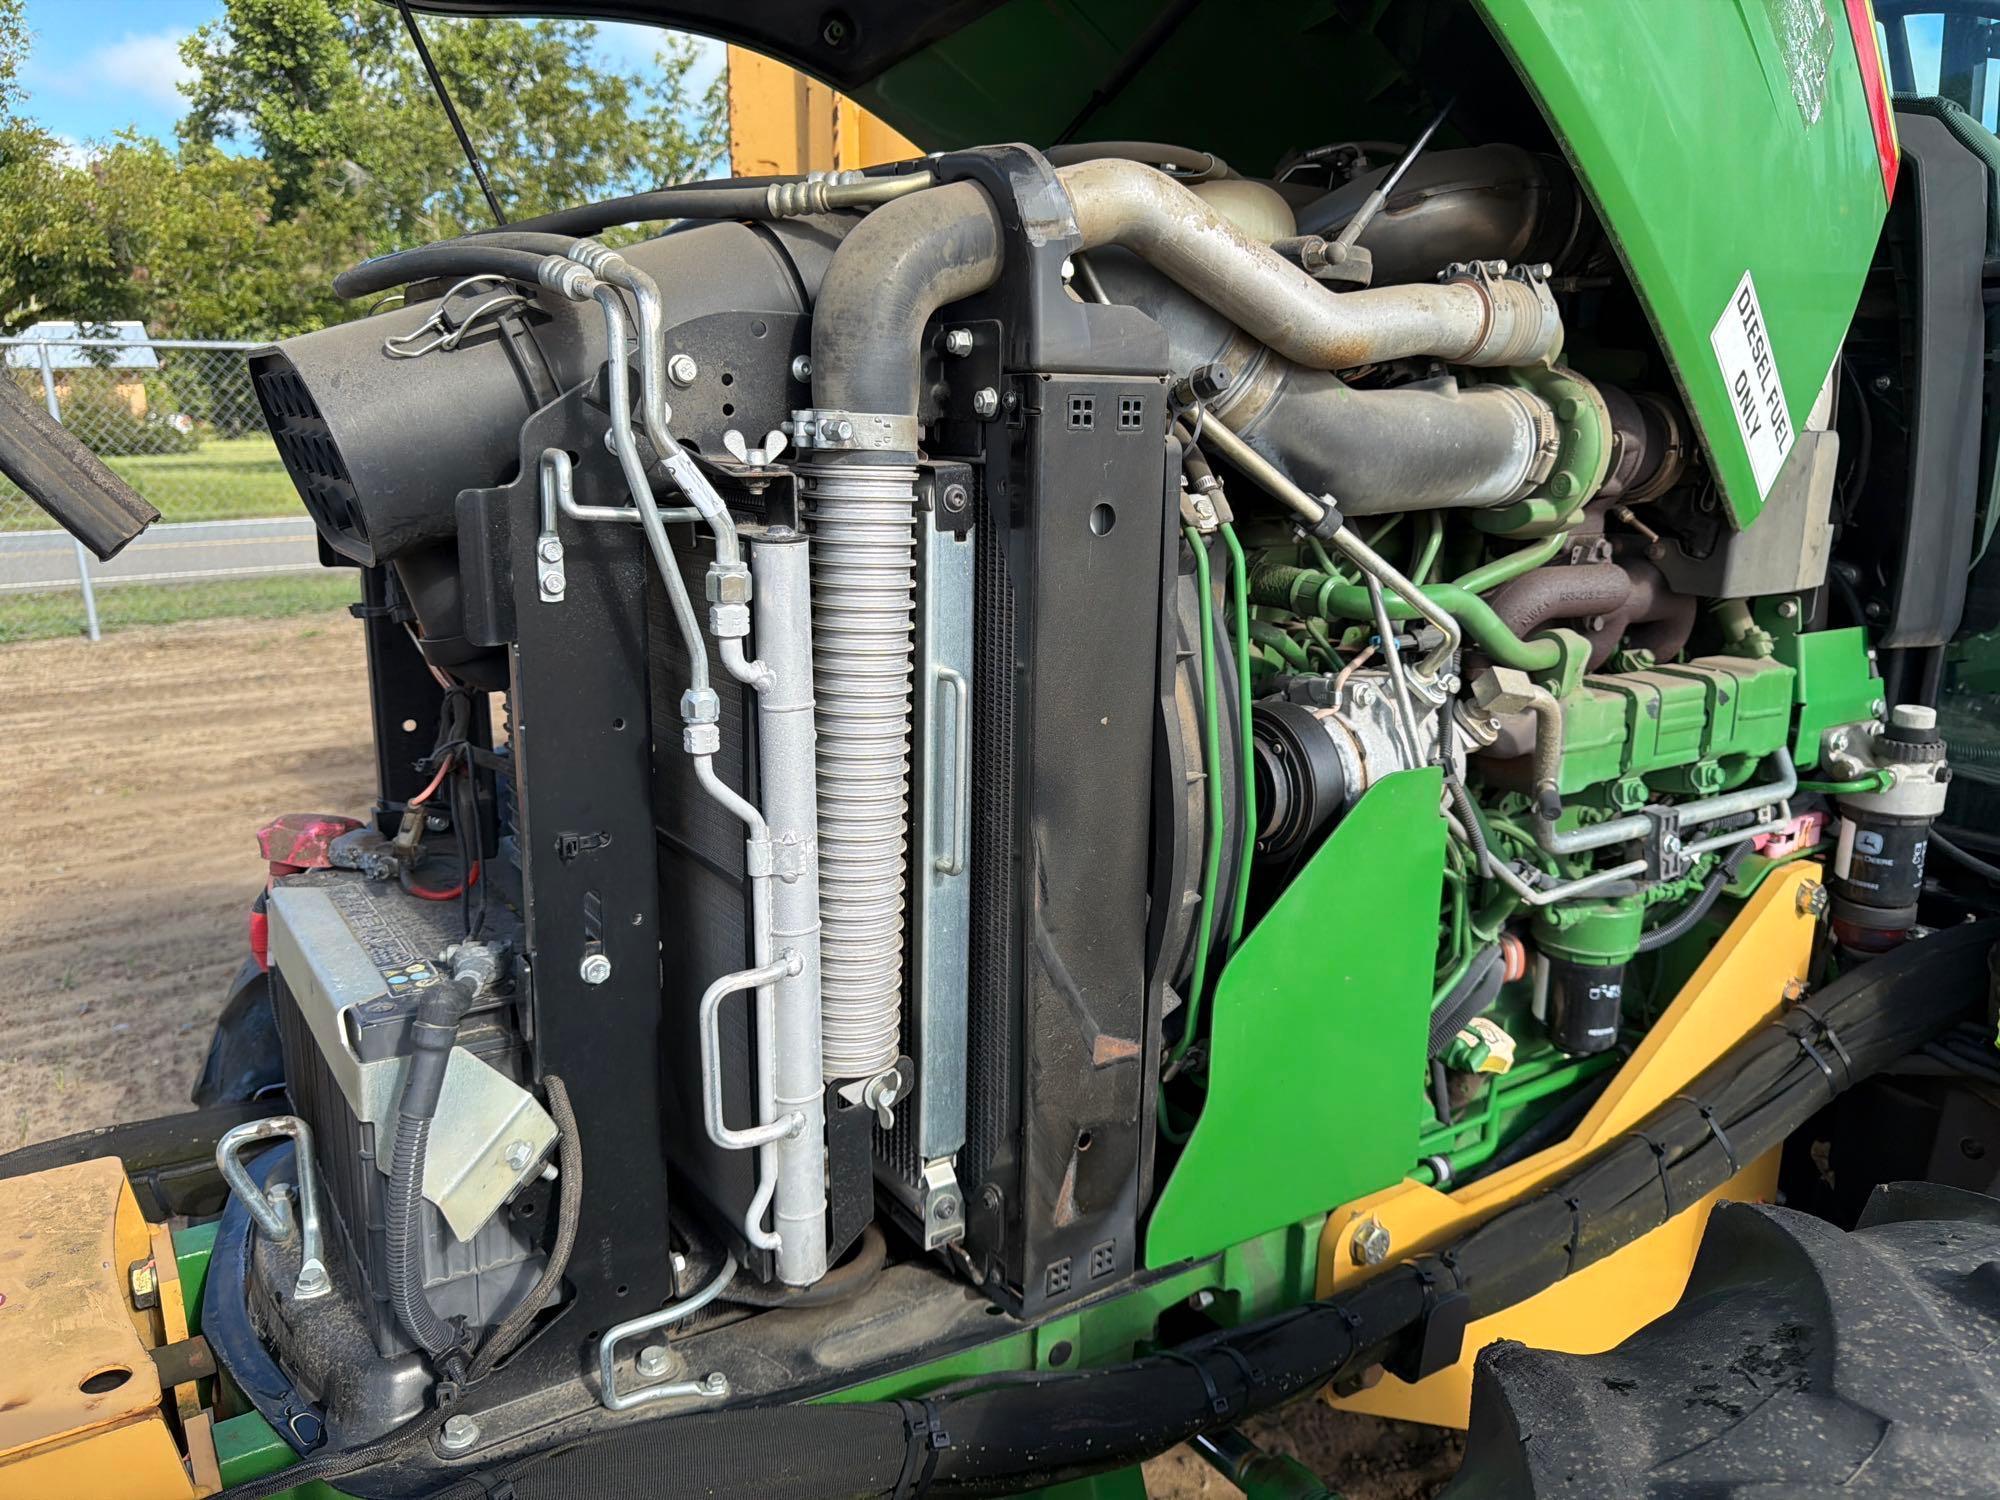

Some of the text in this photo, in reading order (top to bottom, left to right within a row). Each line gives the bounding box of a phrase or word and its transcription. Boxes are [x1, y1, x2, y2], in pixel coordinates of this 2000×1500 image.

[1735, 369, 1761, 441] ONLY
[1737, 286, 1789, 455] DIESEL FUEL
